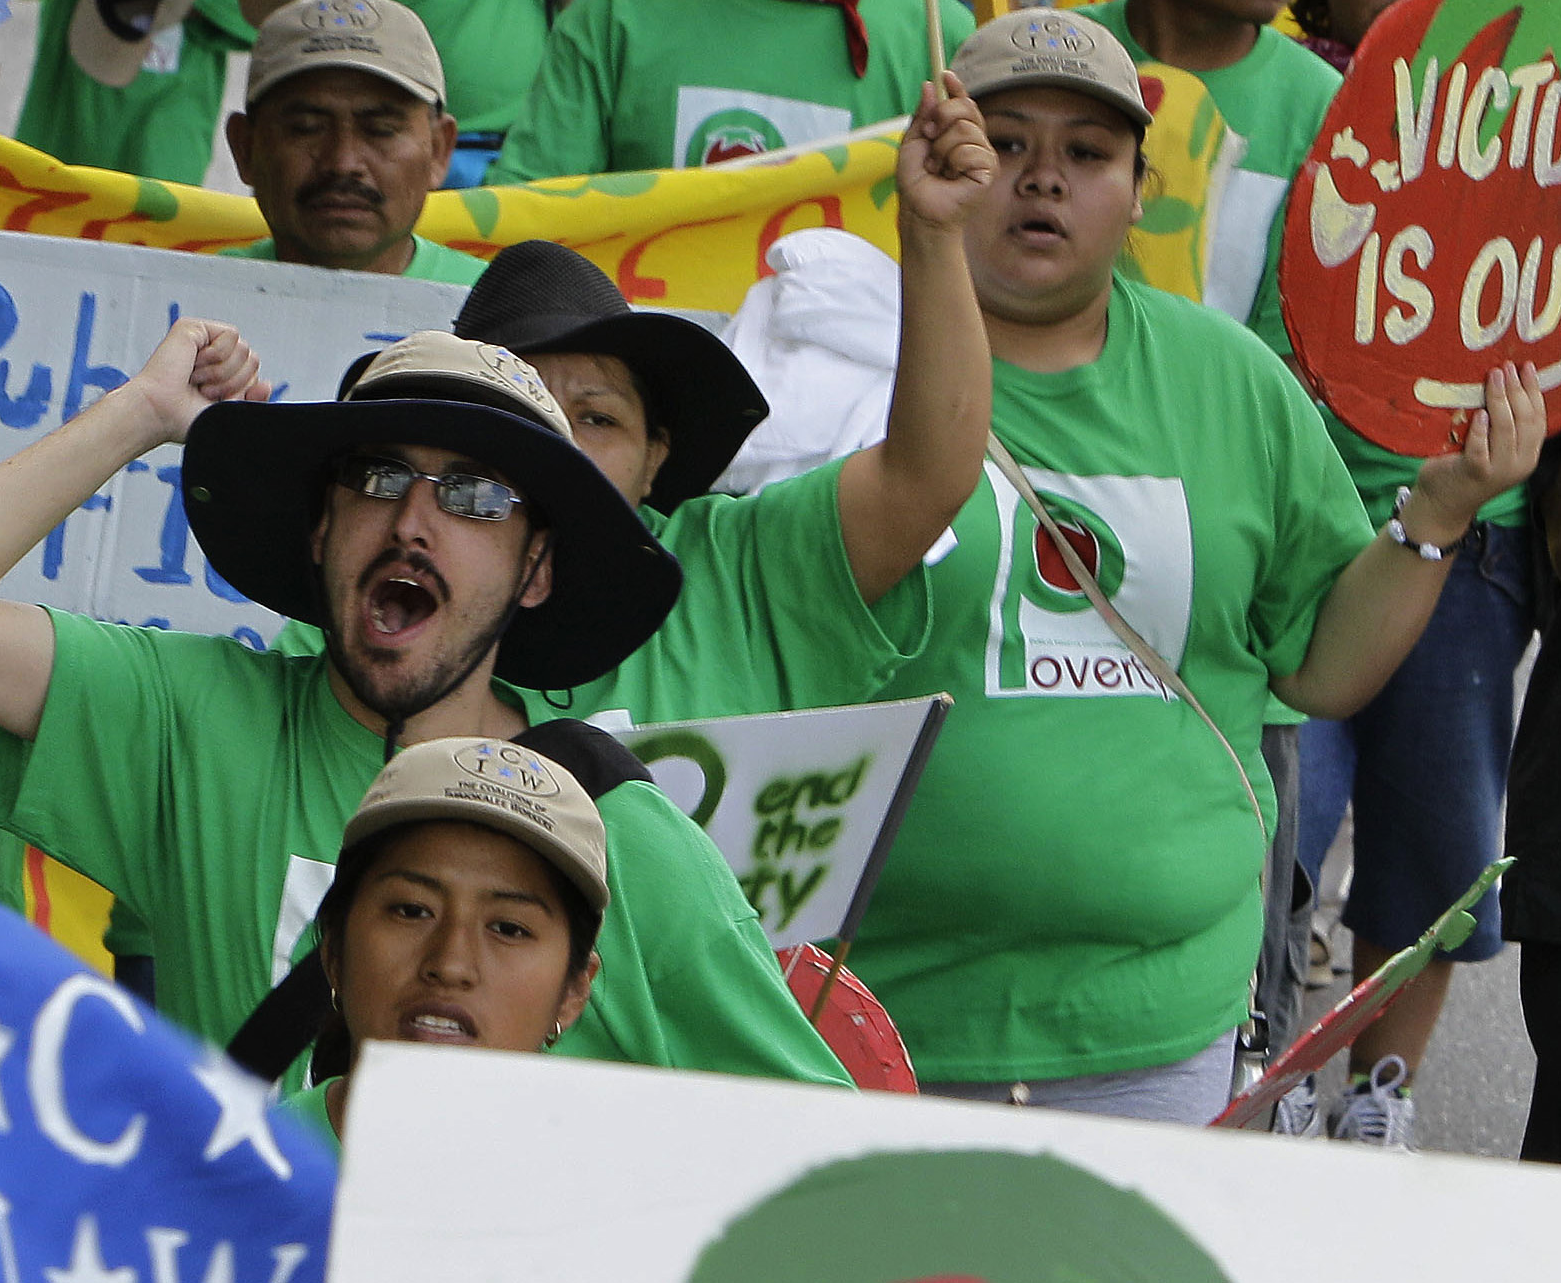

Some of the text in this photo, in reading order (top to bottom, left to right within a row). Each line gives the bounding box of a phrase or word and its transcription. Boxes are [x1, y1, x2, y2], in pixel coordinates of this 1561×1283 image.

[1354, 224, 1435, 345] IS
[754, 751, 874, 816] end
[753, 803, 843, 860] the
[27, 971, 147, 1167] C
